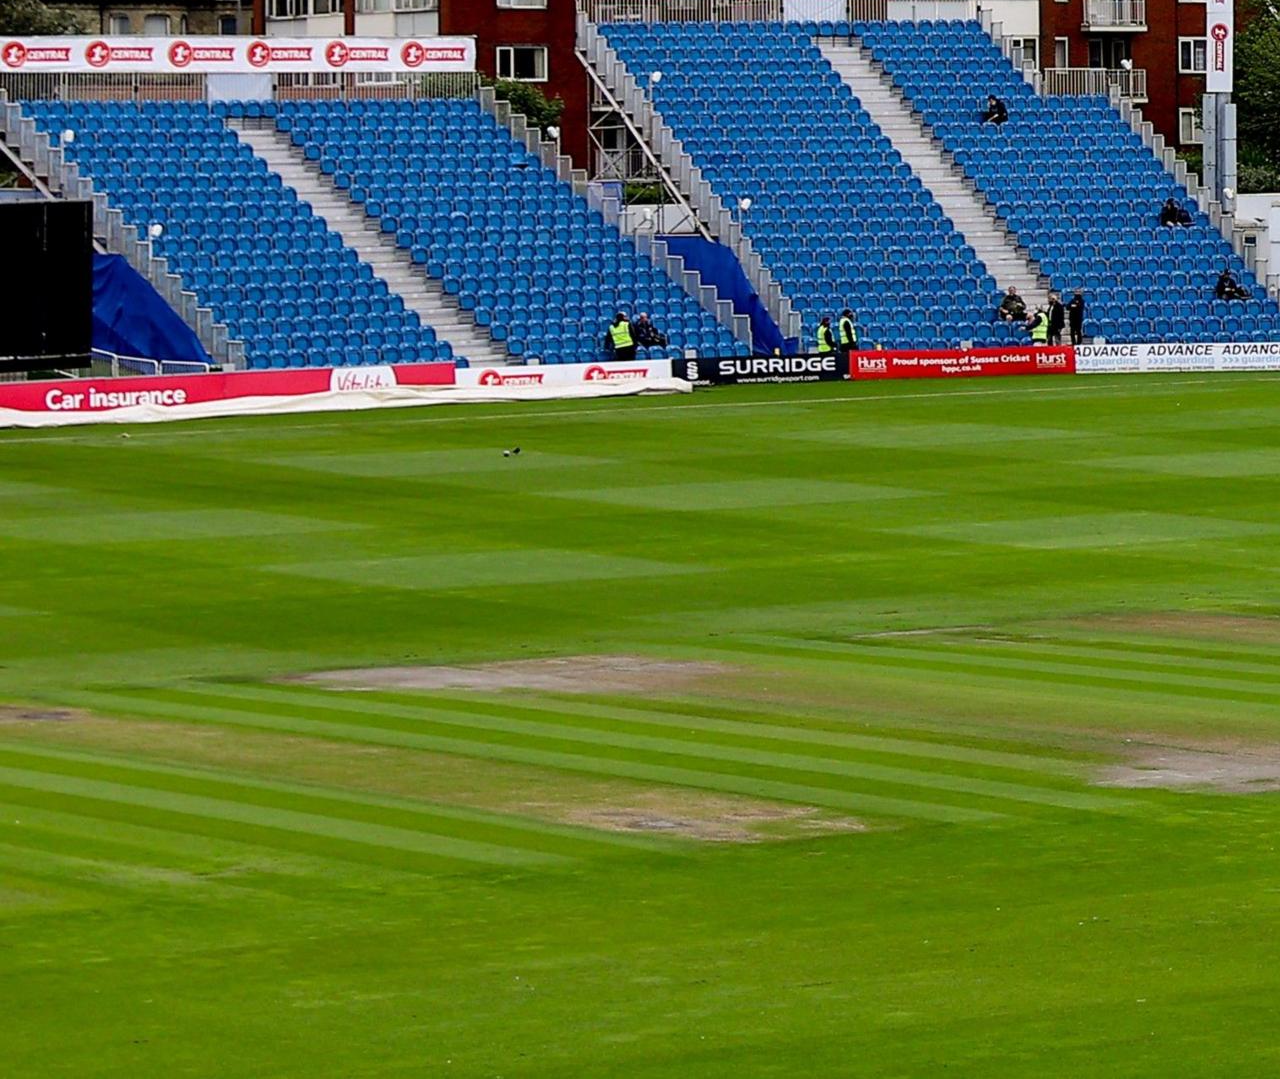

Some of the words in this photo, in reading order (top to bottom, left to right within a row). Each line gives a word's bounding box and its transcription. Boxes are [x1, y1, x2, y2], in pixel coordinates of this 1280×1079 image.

[28, 50, 67, 60] CENTRAL
[112, 50, 150, 60] CENTRAL
[194, 50, 231, 60] CENTRAL
[272, 50, 309, 60] CENTRAL
[350, 50, 386, 60] CENTRAL
[426, 50, 462, 60] CENTRAL
[1075, 346, 1138, 357] ADVANCE
[1147, 344, 1213, 356] ADVANCE
[858, 357, 887, 369] Hurst
[893, 358, 917, 366] Proud
[919, 358, 957, 367] sponsors
[959, 356, 969, 364] of
[970, 356, 998, 364] Sussex
[1001, 355, 1030, 363] Cricket
[1036, 353, 1066, 365] Hurst
[718, 357, 836, 375] SURRIDGE
[46, 389, 83, 410] Car
[90, 388, 186, 408] insurance
